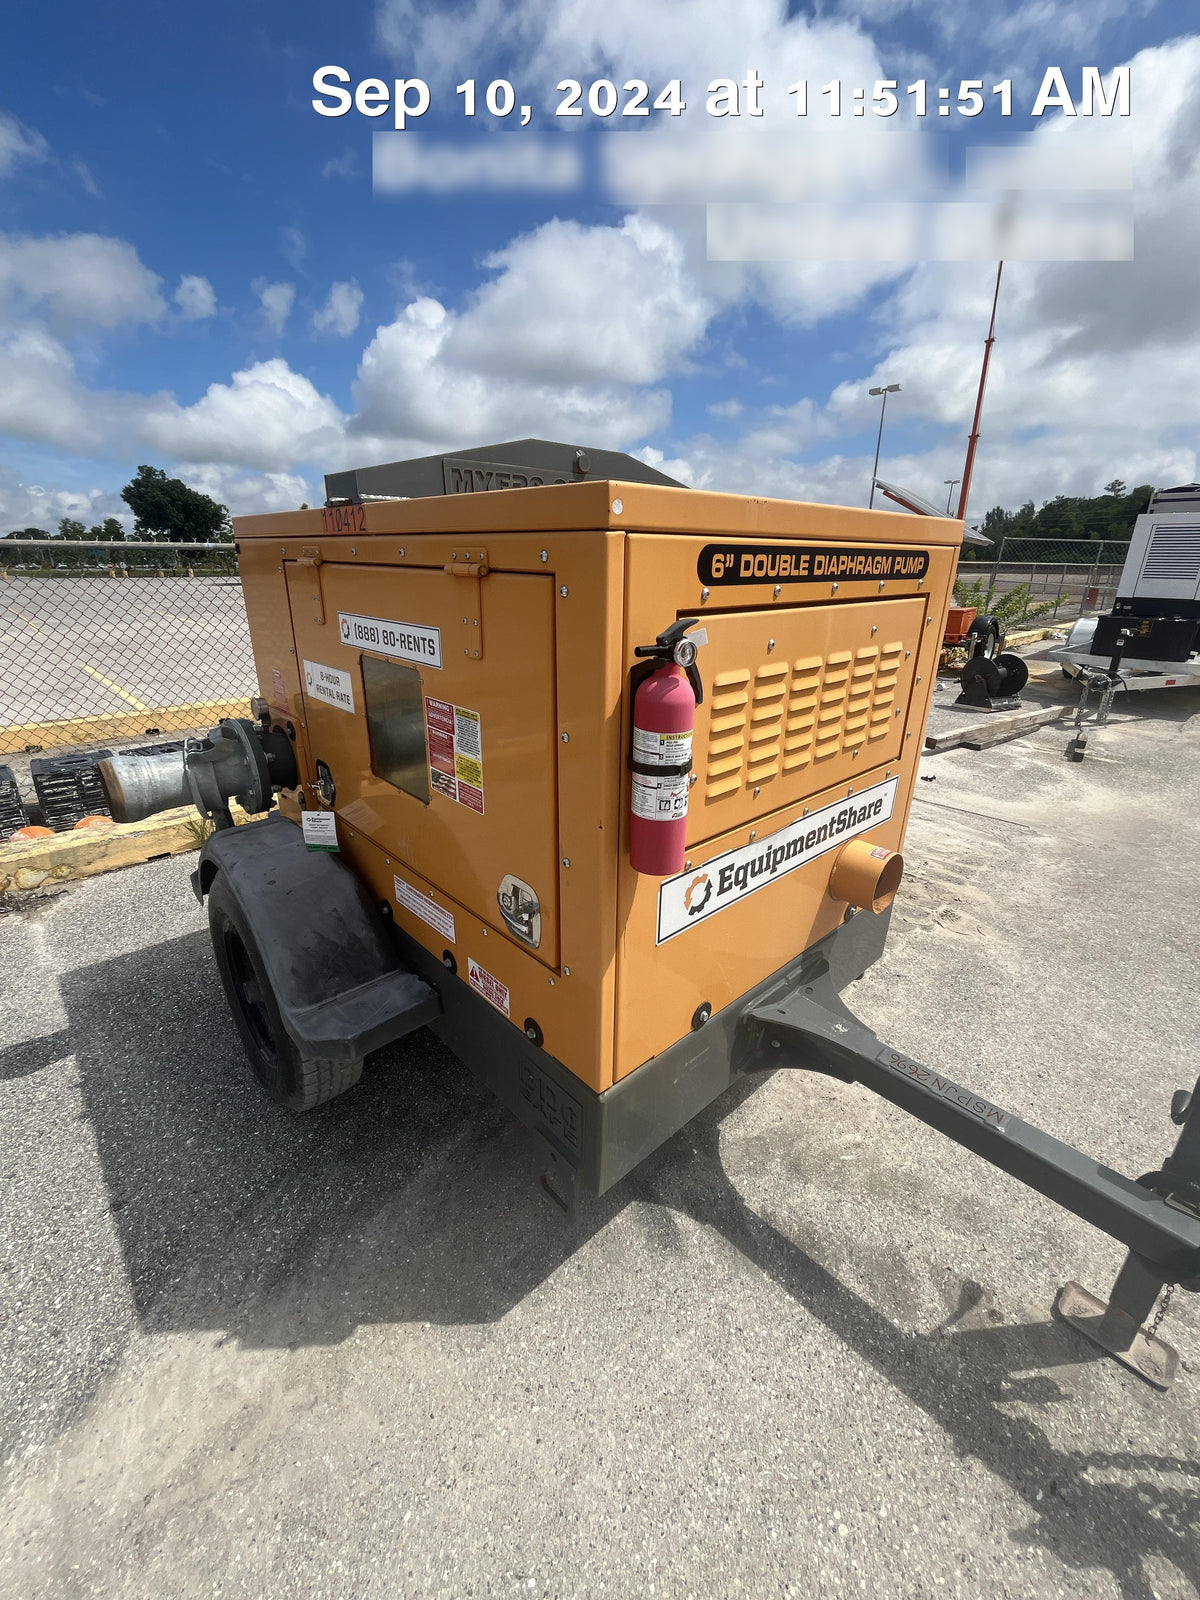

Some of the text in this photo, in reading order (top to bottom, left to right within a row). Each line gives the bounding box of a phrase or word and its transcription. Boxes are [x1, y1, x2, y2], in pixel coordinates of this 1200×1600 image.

[321, 506, 366, 532] 110412
[740, 553, 810, 578] DOUBLE
[813, 555, 892, 576] DIAPHRAGM
[893, 556, 924, 574] PUMP
[354, 622, 436, 656] (888) 80-RENTS
[319, 671, 340, 687] 8-HOUR
[316, 684, 351, 705] RENTAL RATE
[717, 797, 883, 897] EquipmentShare
[890, 1053, 931, 1081] 2696
